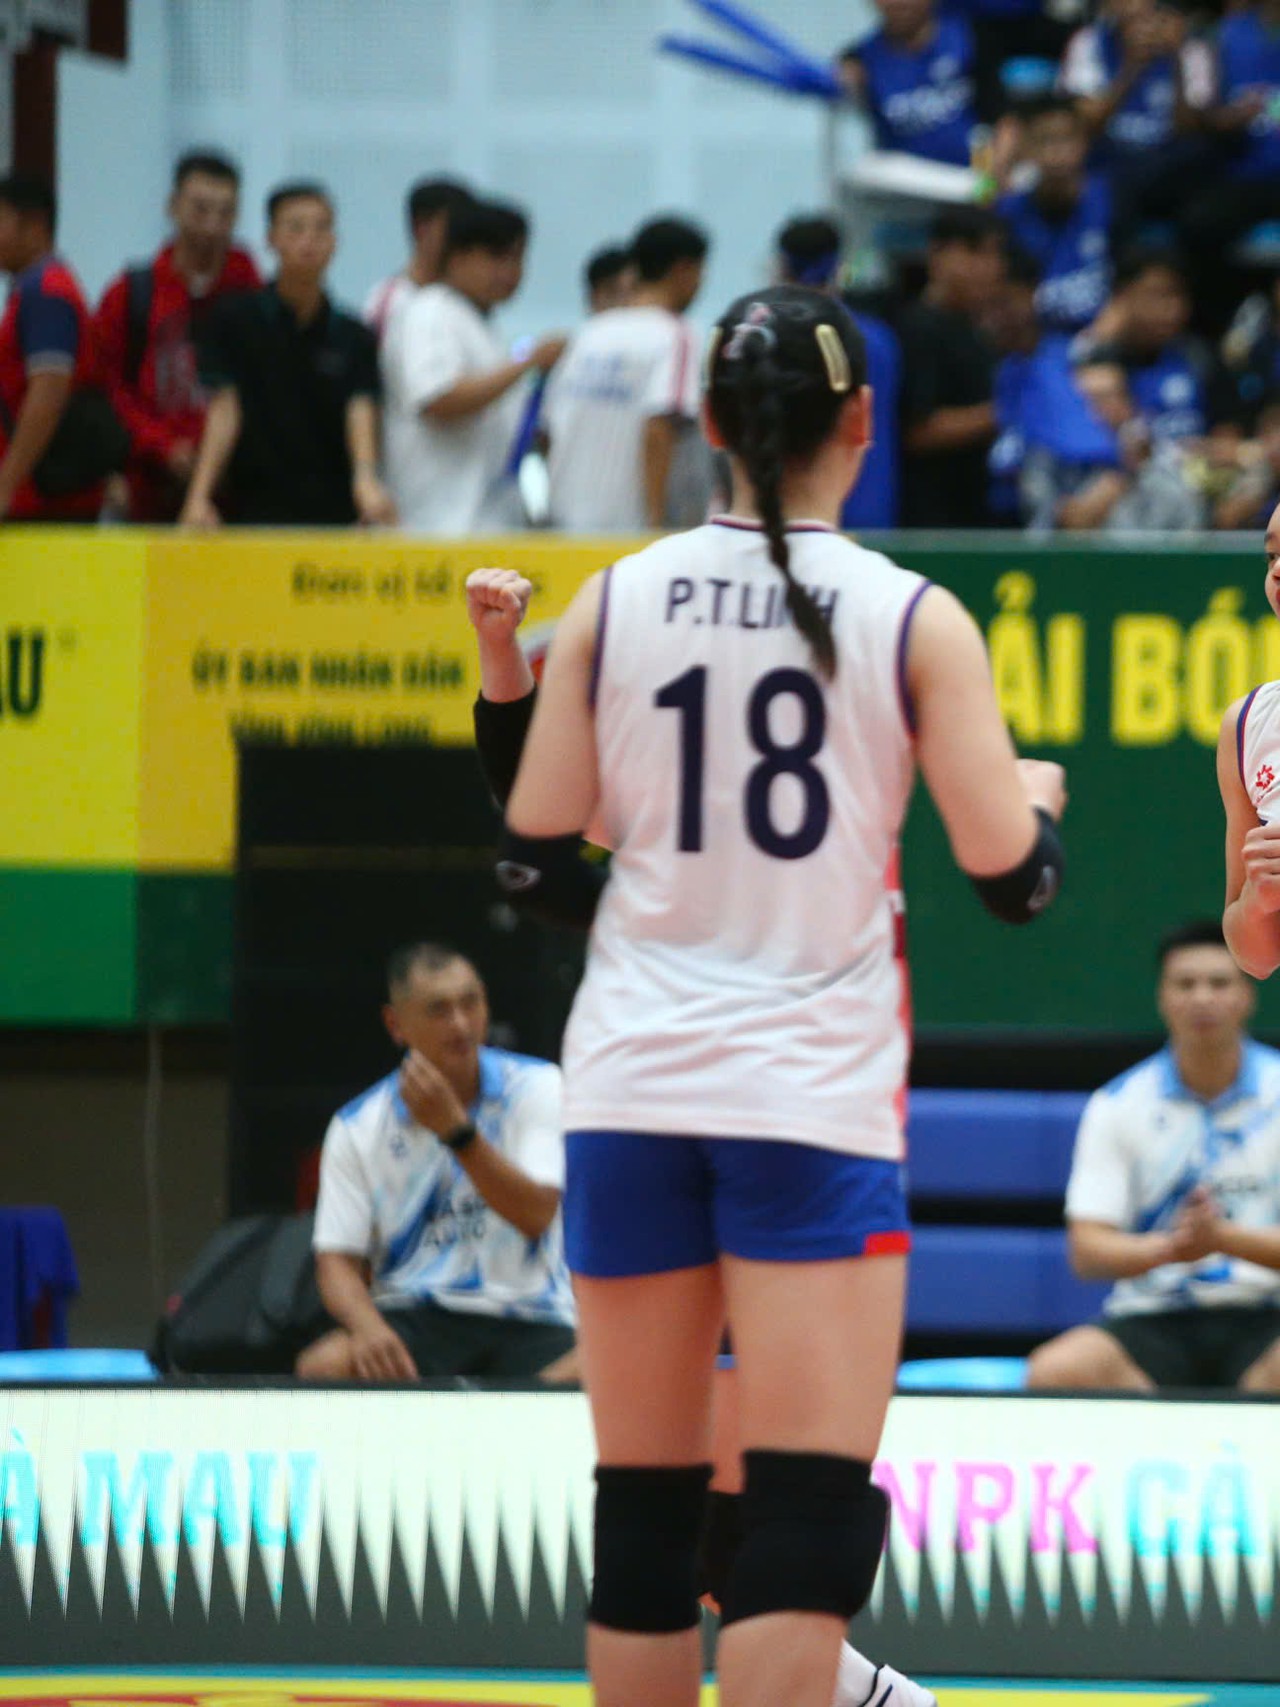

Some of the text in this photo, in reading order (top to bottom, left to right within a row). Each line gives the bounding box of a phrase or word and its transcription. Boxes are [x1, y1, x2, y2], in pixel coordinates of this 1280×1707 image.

[655, 664, 832, 860] 18
[80, 1450, 317, 1548] MAU
[872, 1459, 1100, 1555] NPK
